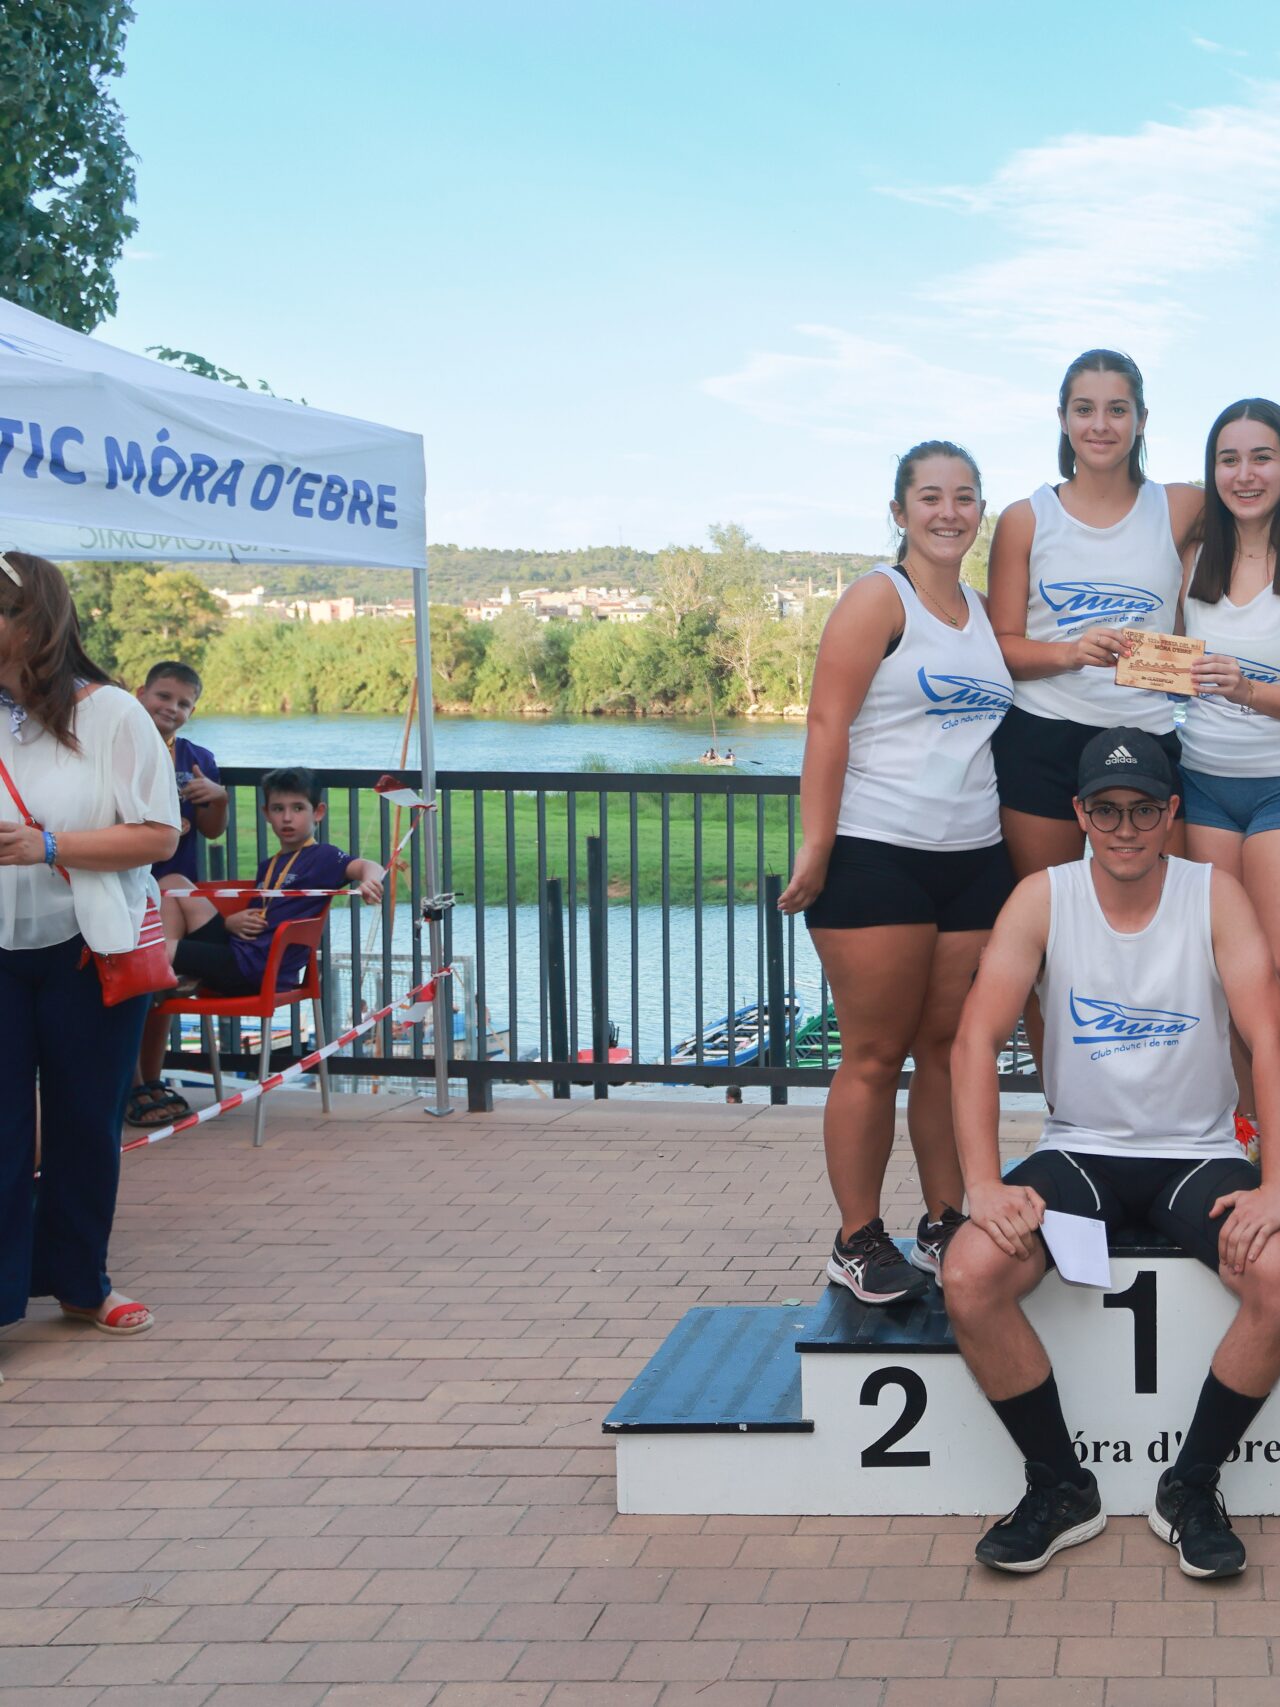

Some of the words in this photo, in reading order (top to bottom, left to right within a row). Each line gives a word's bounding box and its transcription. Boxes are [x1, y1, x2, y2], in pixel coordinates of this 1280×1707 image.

[249, 463, 399, 530] D'EBRE
[942, 719, 958, 729] Club
[988, 711, 996, 720] de
[1105, 756, 1138, 766] adidas
[1090, 1047, 1112, 1061] Club
[1149, 1038, 1160, 1047] de
[1103, 1270, 1157, 1394] 1
[859, 1366, 931, 1468] 2
[1058, 1431, 1134, 1463] óra
